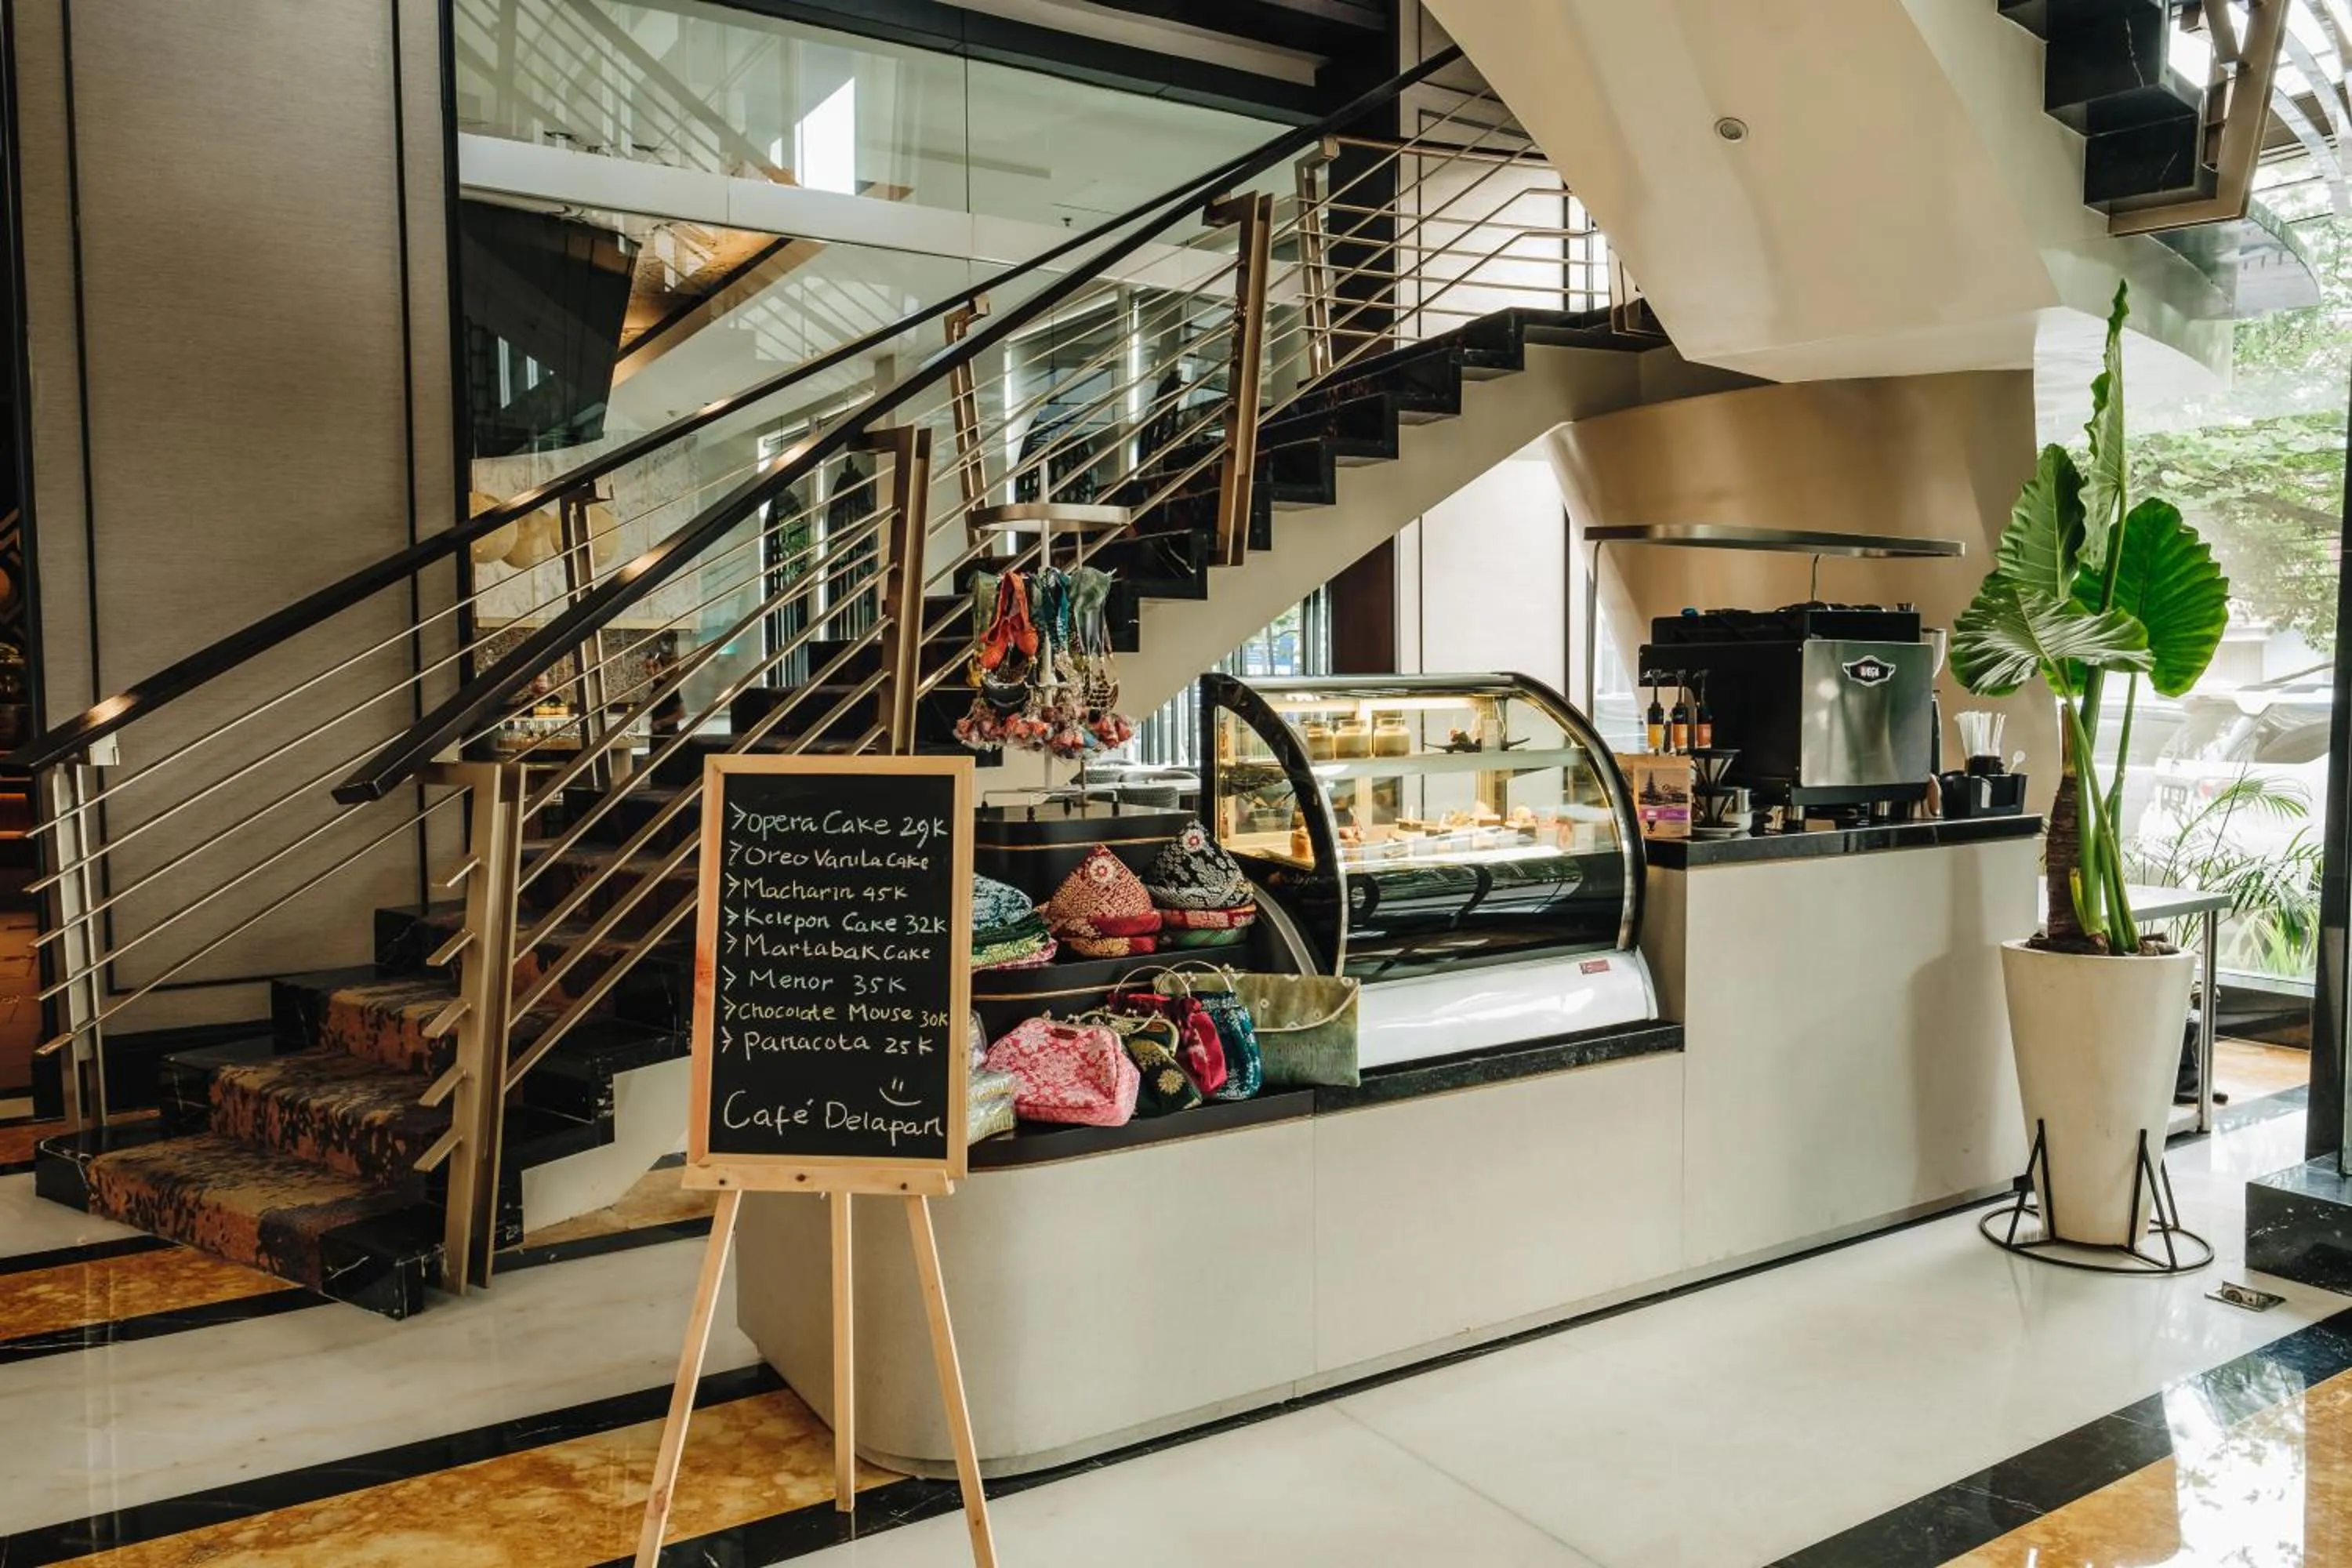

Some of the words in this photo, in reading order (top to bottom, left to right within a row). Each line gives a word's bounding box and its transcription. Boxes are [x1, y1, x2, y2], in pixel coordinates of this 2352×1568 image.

[823, 811, 891, 835] Cake
[745, 848, 808, 866] Oreo
[815, 849, 884, 868] Vanila
[887, 853, 930, 870] Cake
[842, 912, 898, 932] Cake
[884, 945, 931, 960] Cake
[750, 969, 833, 990] Menor
[738, 1003, 838, 1022] Chocolate
[849, 1004, 913, 1022] Mouse
[724, 1091, 814, 1135] Café
[826, 1102, 944, 1147] Delapan
